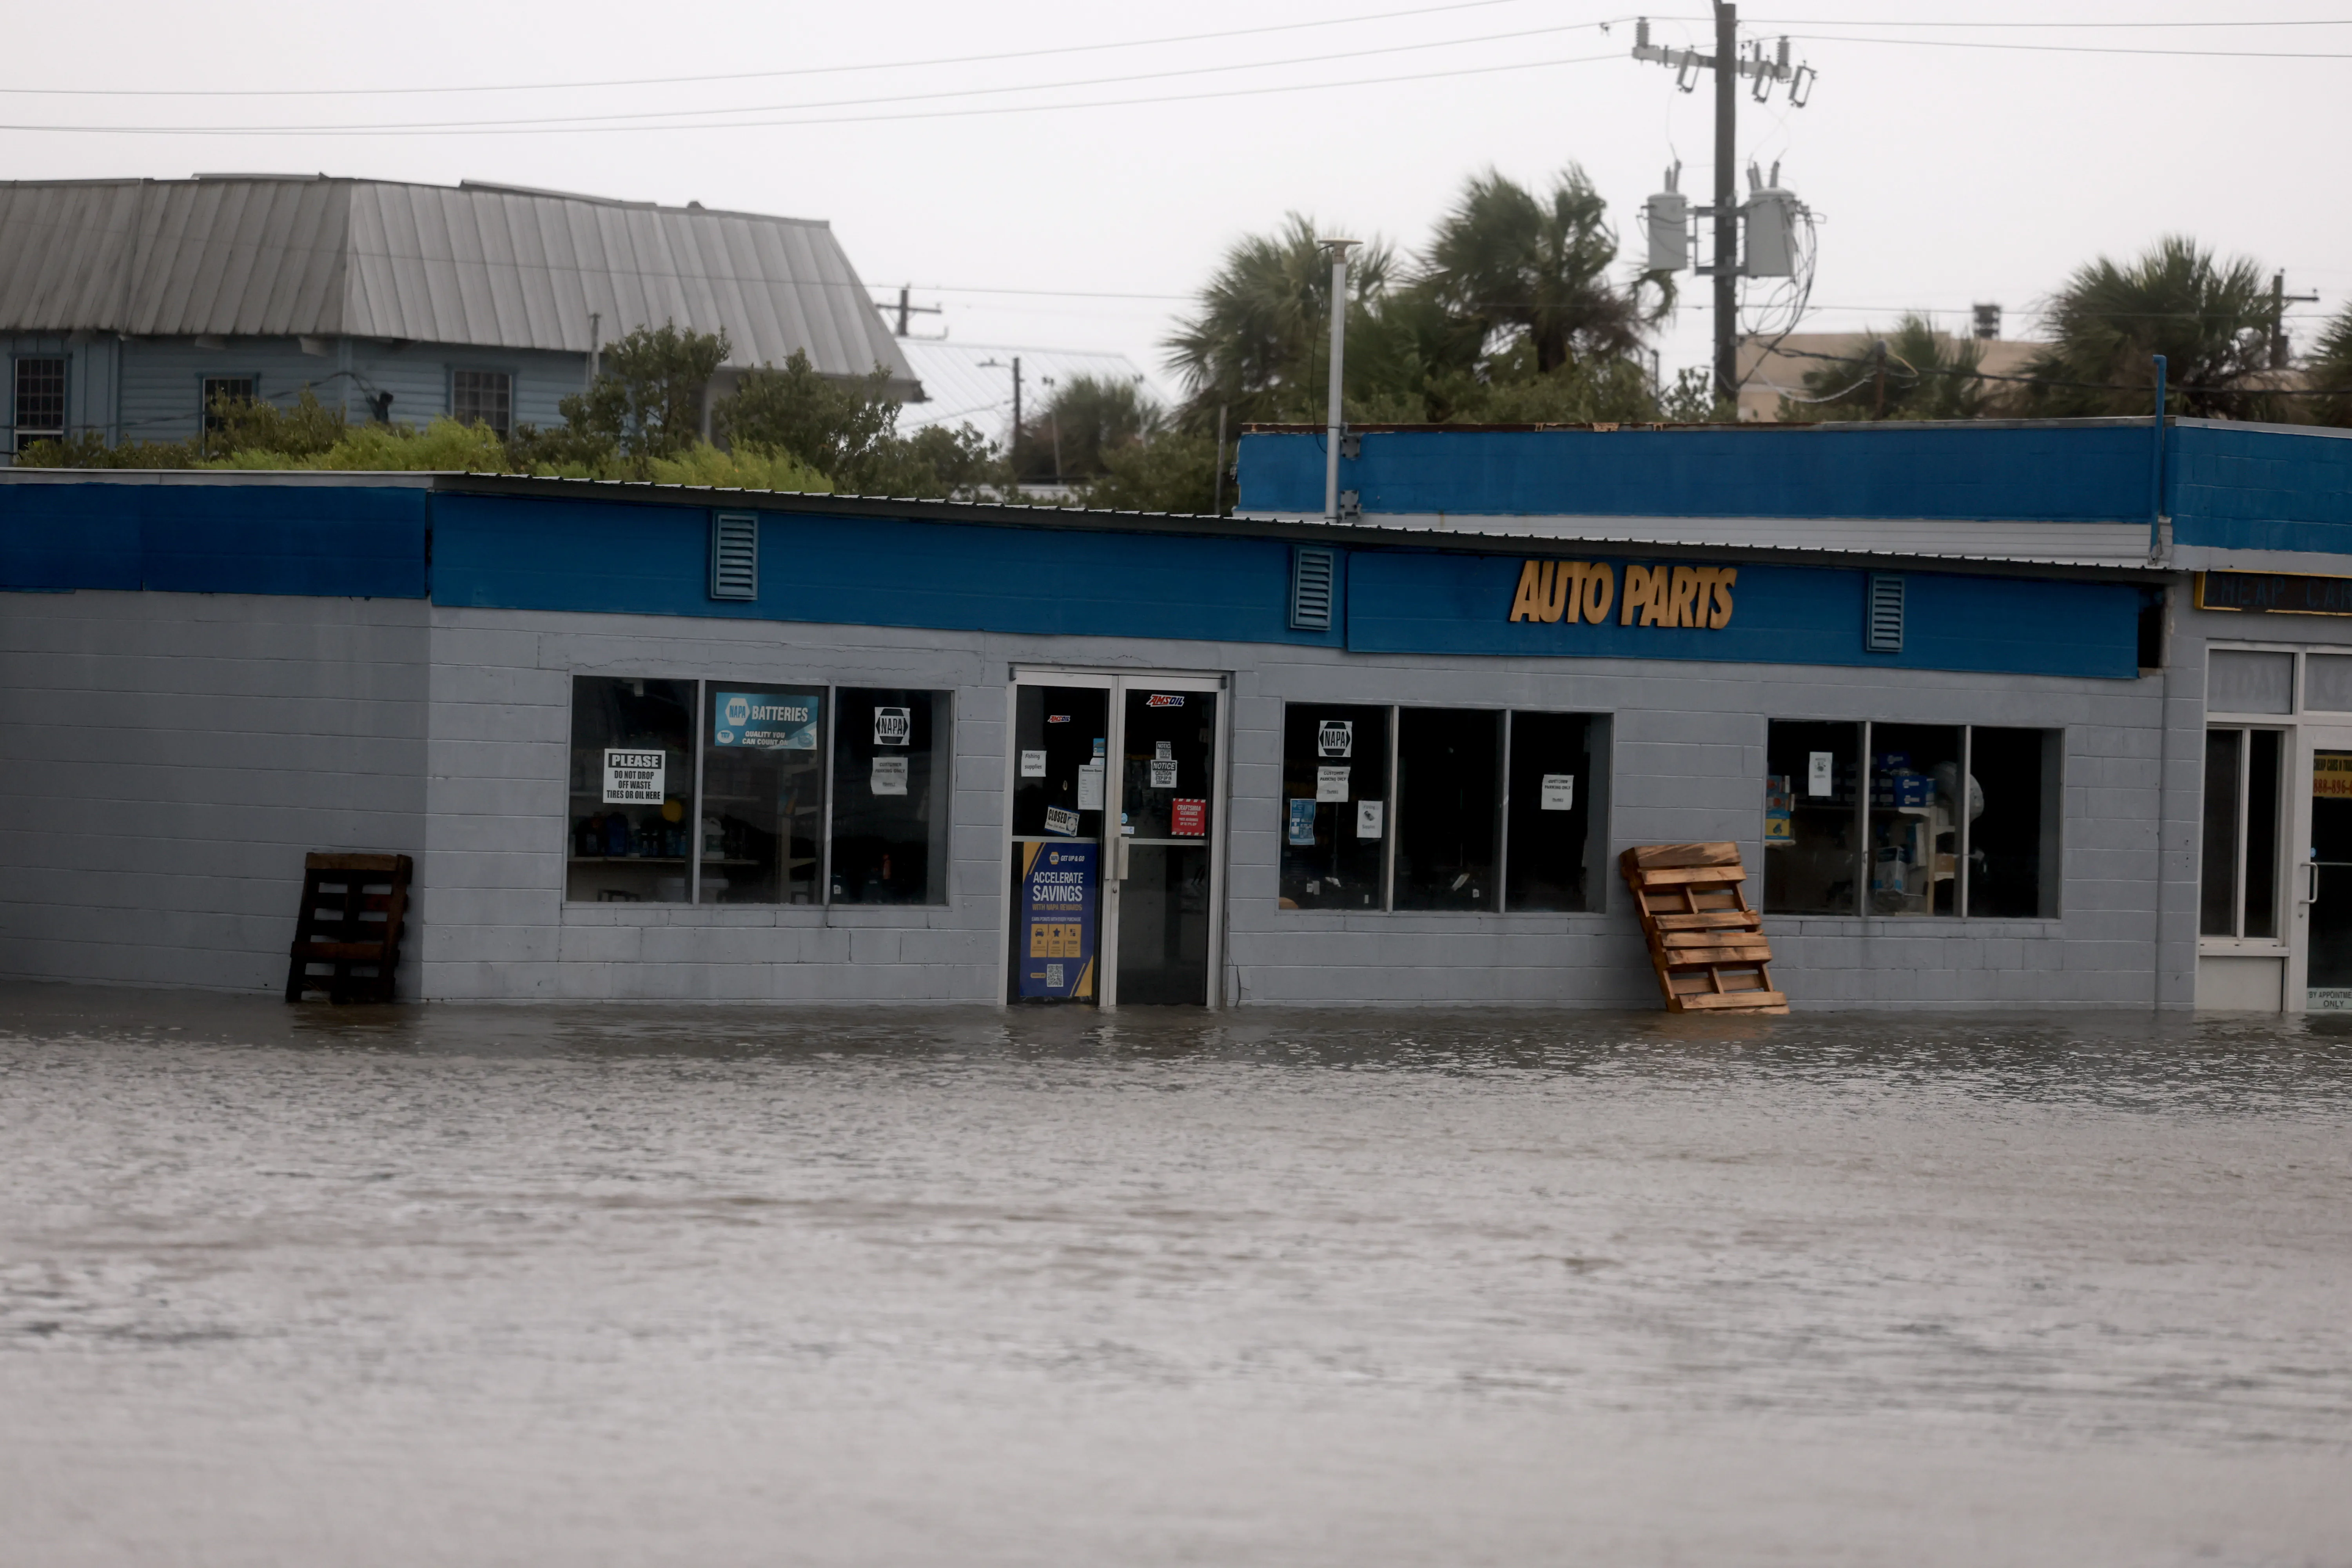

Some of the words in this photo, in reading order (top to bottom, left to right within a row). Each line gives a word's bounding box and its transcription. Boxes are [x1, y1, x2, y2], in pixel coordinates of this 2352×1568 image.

[1510, 560, 1614, 624] AUTO
[1621, 565, 1738, 629] PARTS
[1148, 695, 1183, 706] AMSOIL
[730, 705, 745, 718] NAPA
[751, 706, 808, 722] BATTERIES
[882, 718, 902, 735] NAPA
[1325, 731, 1346, 747] NAPA
[612, 755, 659, 767] PLEASE
[614, 770, 623, 779] DO
[618, 780, 629, 789] OFF
[630, 781, 651, 789] WASTE
[606, 790, 624, 798] TIRES
[646, 791, 661, 800] HERE
[1048, 809, 1067, 824] CLOSED
[1033, 872, 1083, 884] ACCELERATE
[1033, 885, 1083, 902] SAVINGS
